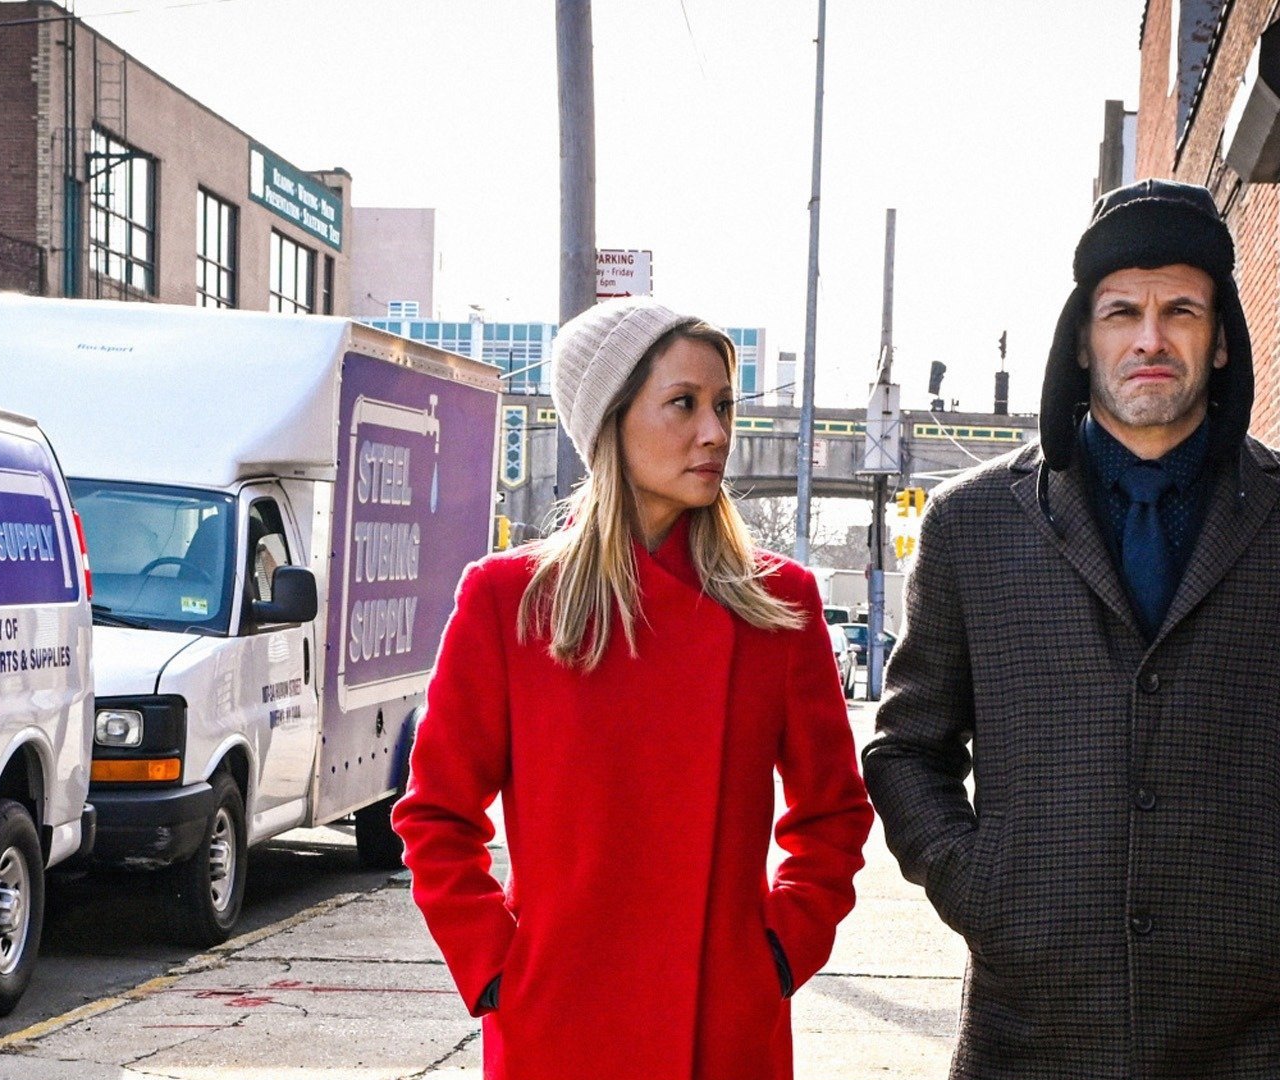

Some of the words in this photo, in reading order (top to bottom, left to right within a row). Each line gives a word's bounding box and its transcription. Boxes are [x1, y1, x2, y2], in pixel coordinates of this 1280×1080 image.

[611, 267, 634, 277] Friday
[357, 440, 412, 505] STEEL
[354, 521, 420, 583] TUBING
[5, 617, 19, 640] OF
[349, 597, 418, 663] SUPPLY
[20, 649, 28, 670] &
[30, 646, 70, 670] SUPPLIES
